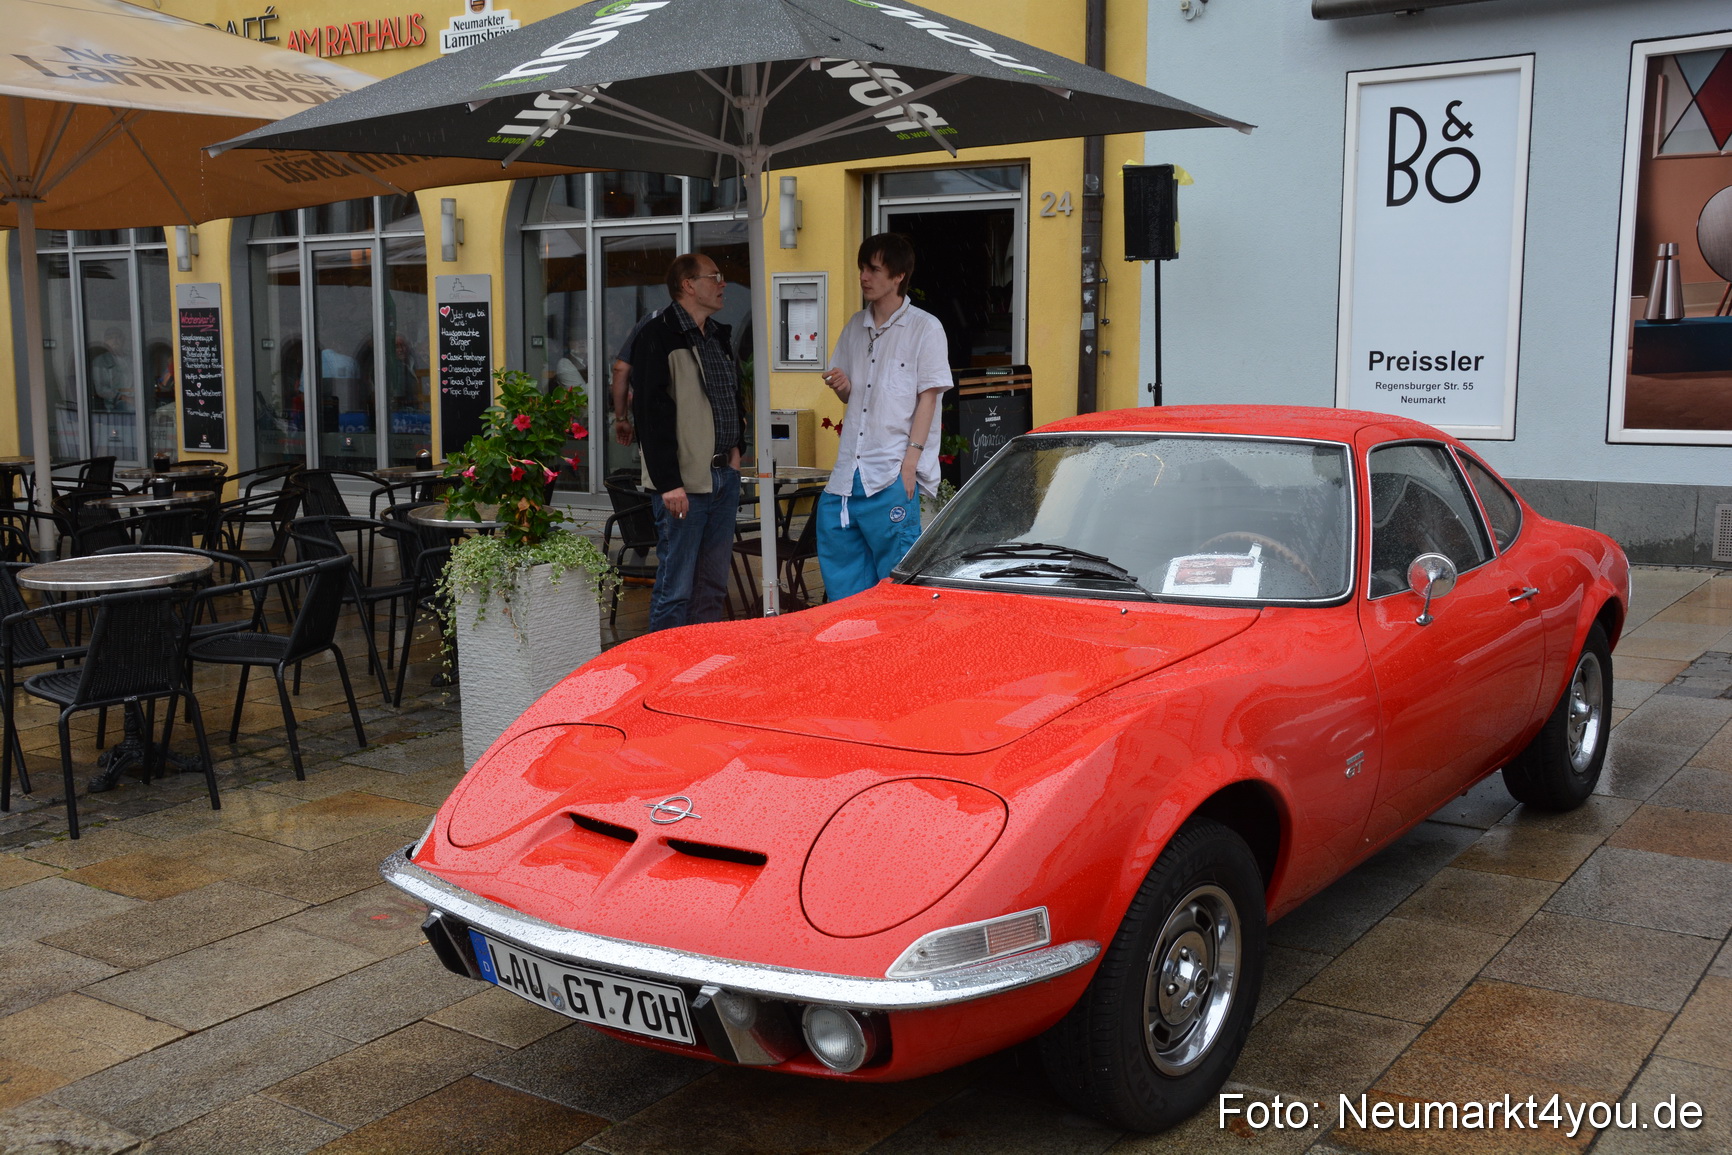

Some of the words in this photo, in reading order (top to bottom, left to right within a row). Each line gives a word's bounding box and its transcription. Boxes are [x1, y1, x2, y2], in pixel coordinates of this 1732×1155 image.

[287, 27, 321, 57] AM
[326, 13, 427, 56] RATHAUS
[453, 15, 505, 31] Neumarkter
[444, 26, 515, 49] Lammsbrä
[55, 45, 338, 87] Neumarkter
[10, 54, 353, 104] Lammsbr
[1040, 190, 1074, 218] 24
[1368, 350, 1485, 372] Preissler
[1375, 381, 1441, 392] Regensburger
[1443, 381, 1460, 390] Str.
[1462, 382, 1474, 391] 55
[1400, 395, 1446, 404] Neumarkt
[483, 960, 491, 973] D
[488, 943, 547, 1002] LAU
[562, 973, 607, 1020] GT
[613, 983, 689, 1038] 70H
